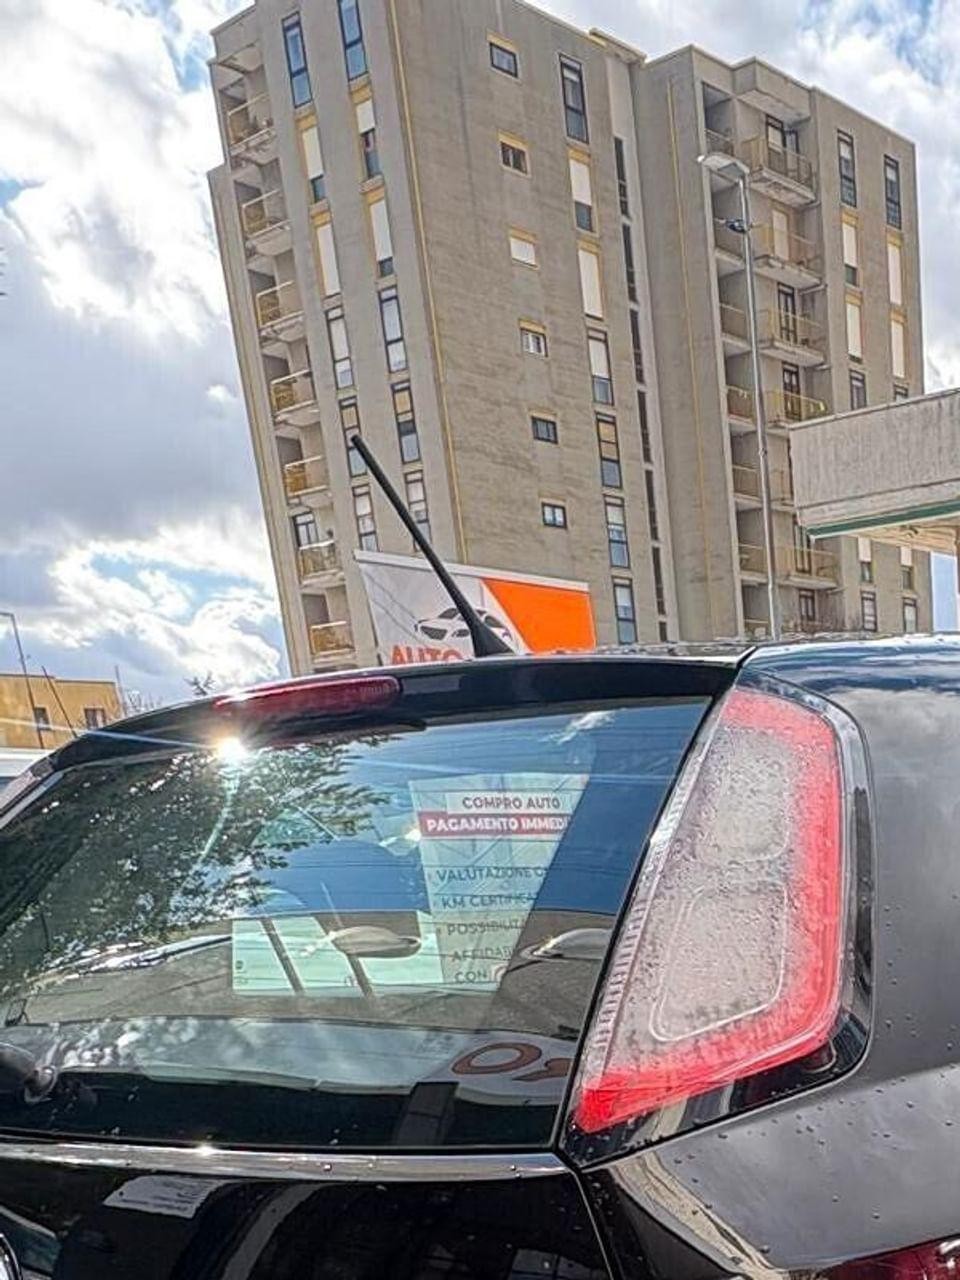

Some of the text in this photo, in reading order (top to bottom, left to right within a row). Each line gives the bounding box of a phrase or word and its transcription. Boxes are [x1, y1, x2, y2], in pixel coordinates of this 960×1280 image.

[462, 796, 561, 810] COMPRO AUTO
[426, 817, 517, 832] PAGAMENTO
[436, 866, 532, 882] VALUTAZIONE
[441, 895, 465, 909] KM
[454, 970, 487, 984] CON
